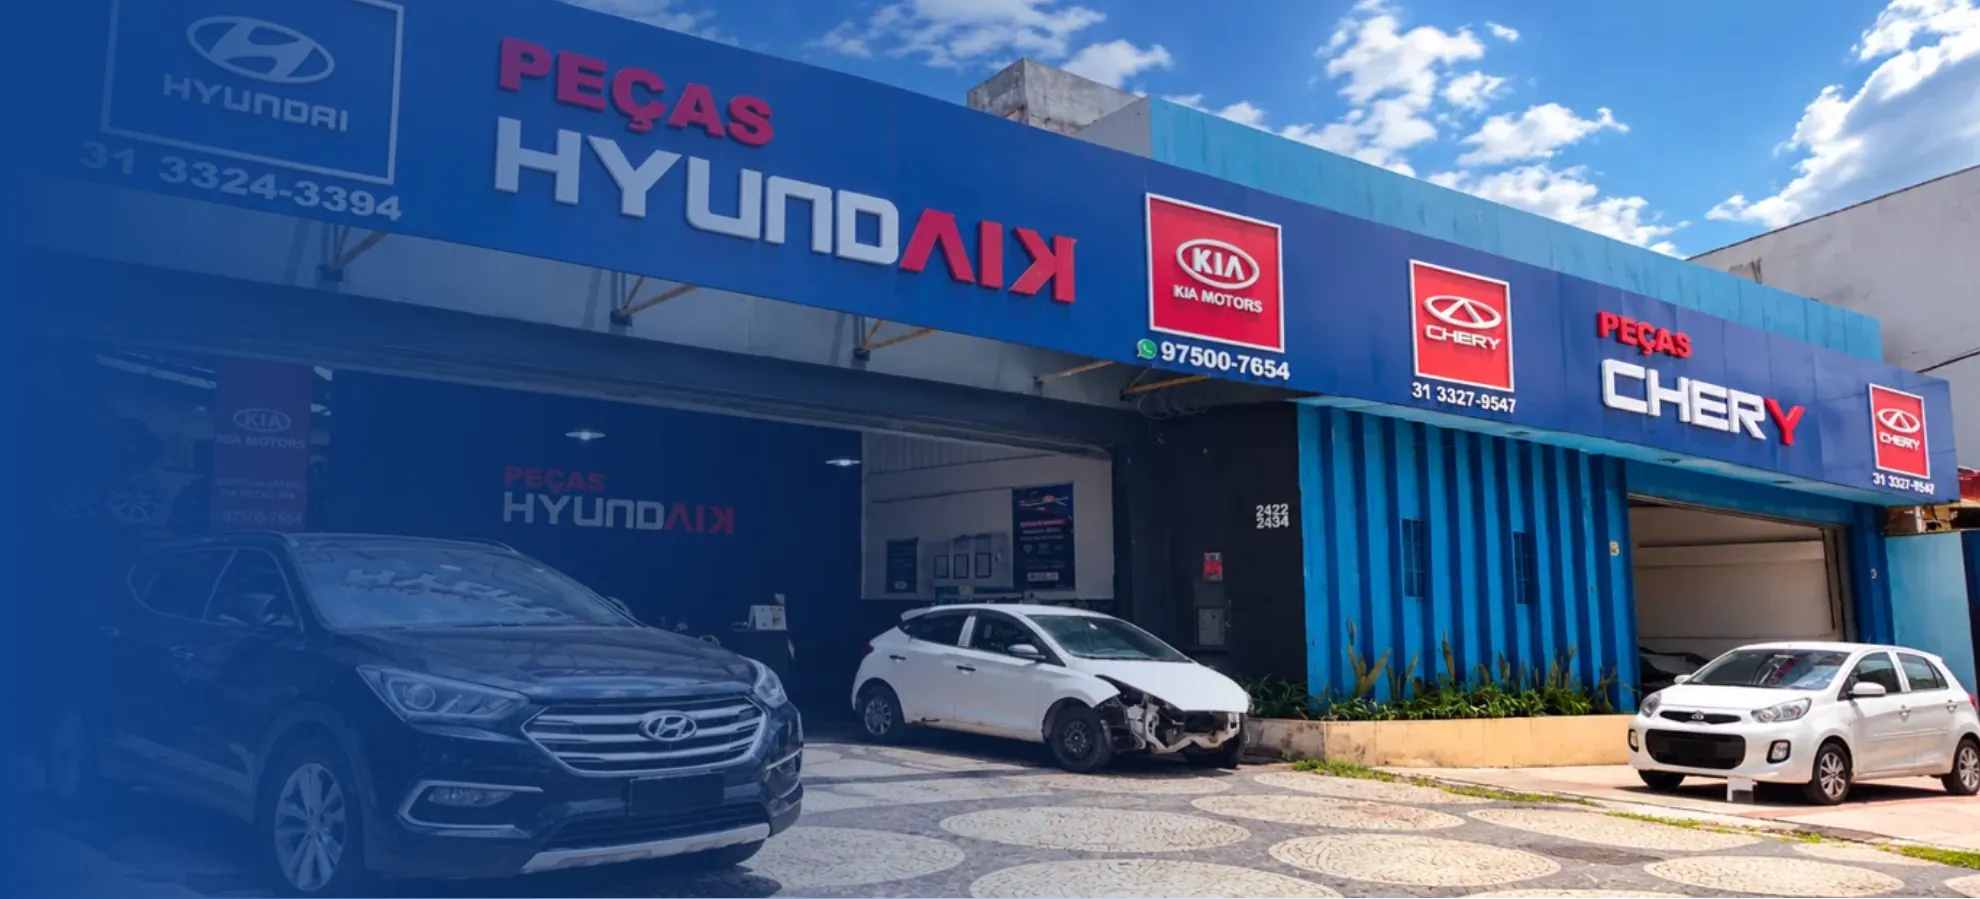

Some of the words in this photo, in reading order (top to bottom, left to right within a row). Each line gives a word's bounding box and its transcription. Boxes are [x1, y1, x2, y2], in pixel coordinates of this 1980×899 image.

[162, 73, 349, 132] HYUNDAI
[499, 37, 774, 147] PEÇAS
[80, 140, 136, 175] 31
[158, 155, 402, 221] 3324-3394
[1192, 247, 1246, 281] KIA
[1173, 285, 1199, 301] KIA
[1201, 290, 1263, 313] MOTORS
[1425, 324, 1501, 350] CHERY
[1596, 311, 1693, 358] PEÇAS
[1160, 341, 1291, 380] 97500-7654
[1411, 381, 1431, 400] 31
[1436, 386, 1517, 413] 3327-9547
[1601, 358, 1806, 445] CHERY
[244, 412, 283, 429] KIA
[215, 432, 242, 445] KIA
[245, 435, 306, 450] MOTORS
[1879, 431, 1921, 451] CHERY
[504, 465, 606, 494] PEÇAS
[1872, 472, 1886, 486] 31
[1255, 503, 1289, 517] 2422
[1256, 515, 1290, 529] 2434
